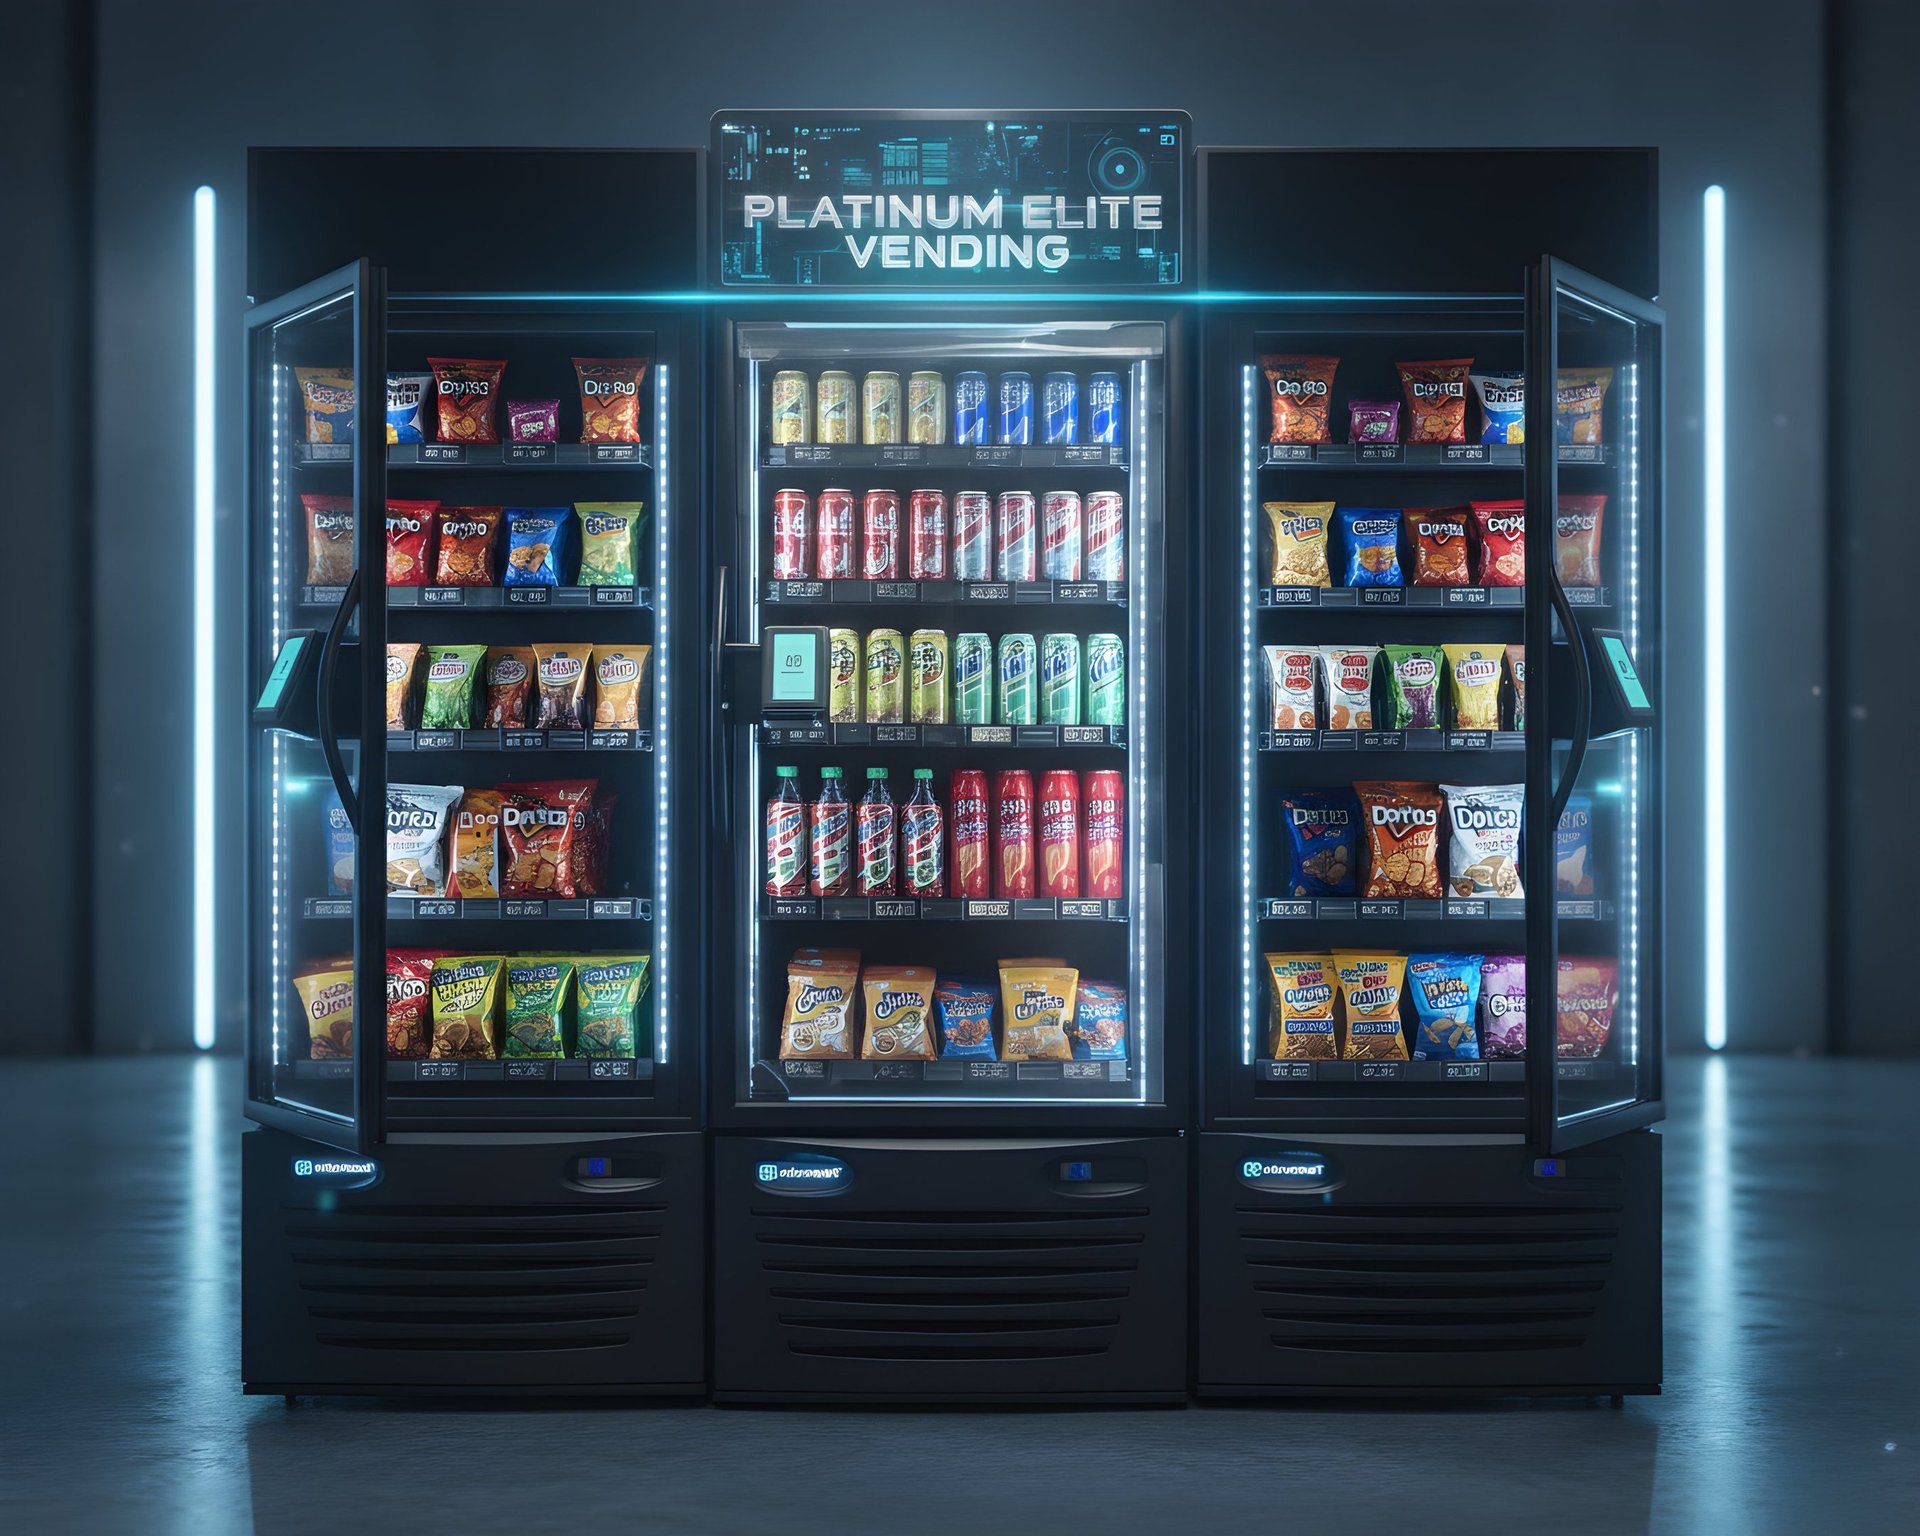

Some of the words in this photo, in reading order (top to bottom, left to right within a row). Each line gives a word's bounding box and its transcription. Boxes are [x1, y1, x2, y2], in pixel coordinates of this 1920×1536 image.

[744, 194, 1003, 229] PLATINUM
[1022, 194, 1163, 229] ELITE
[845, 234, 1070, 269] VENDING
